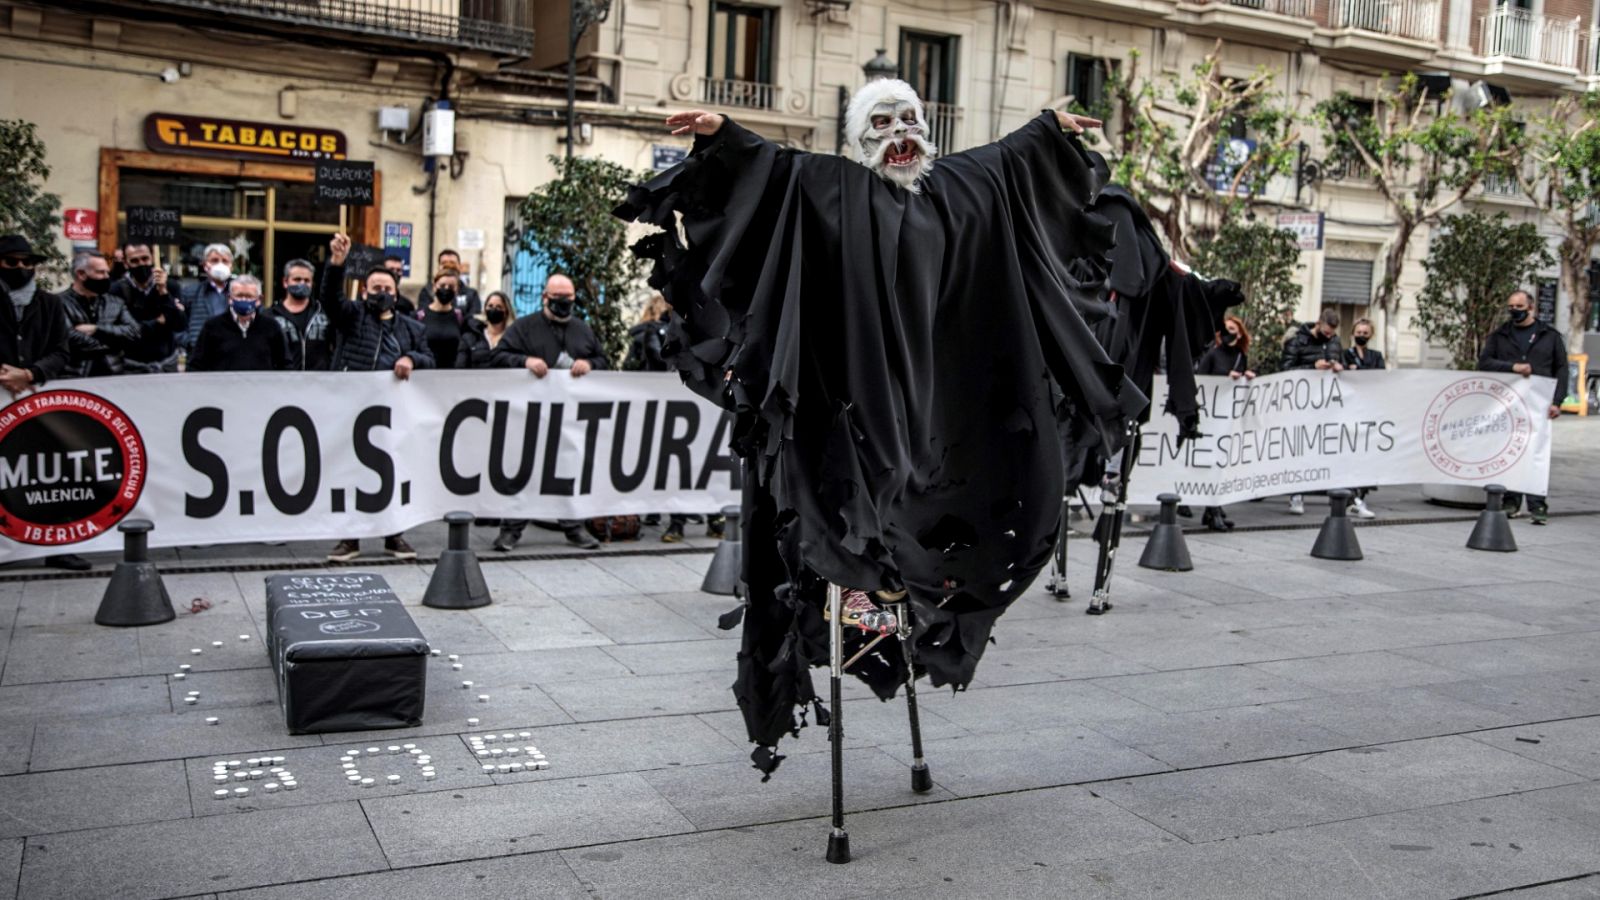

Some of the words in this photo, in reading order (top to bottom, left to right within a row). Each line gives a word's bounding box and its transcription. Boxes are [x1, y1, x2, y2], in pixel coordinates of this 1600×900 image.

[201, 123, 337, 152] TABACOS
[319, 166, 374, 183] QUEREMOS
[1444, 380, 1485, 402] ALERTA
[17, 403, 33, 416] DE
[111, 417, 129, 436] DEL
[1450, 422, 1508, 441] EVENTOS
[0, 447, 123, 490] M.U.T.E.
[181, 405, 411, 519] S.O.S.
[439, 398, 742, 497] CULTURA
[25, 487, 96, 505] VALENCIA
